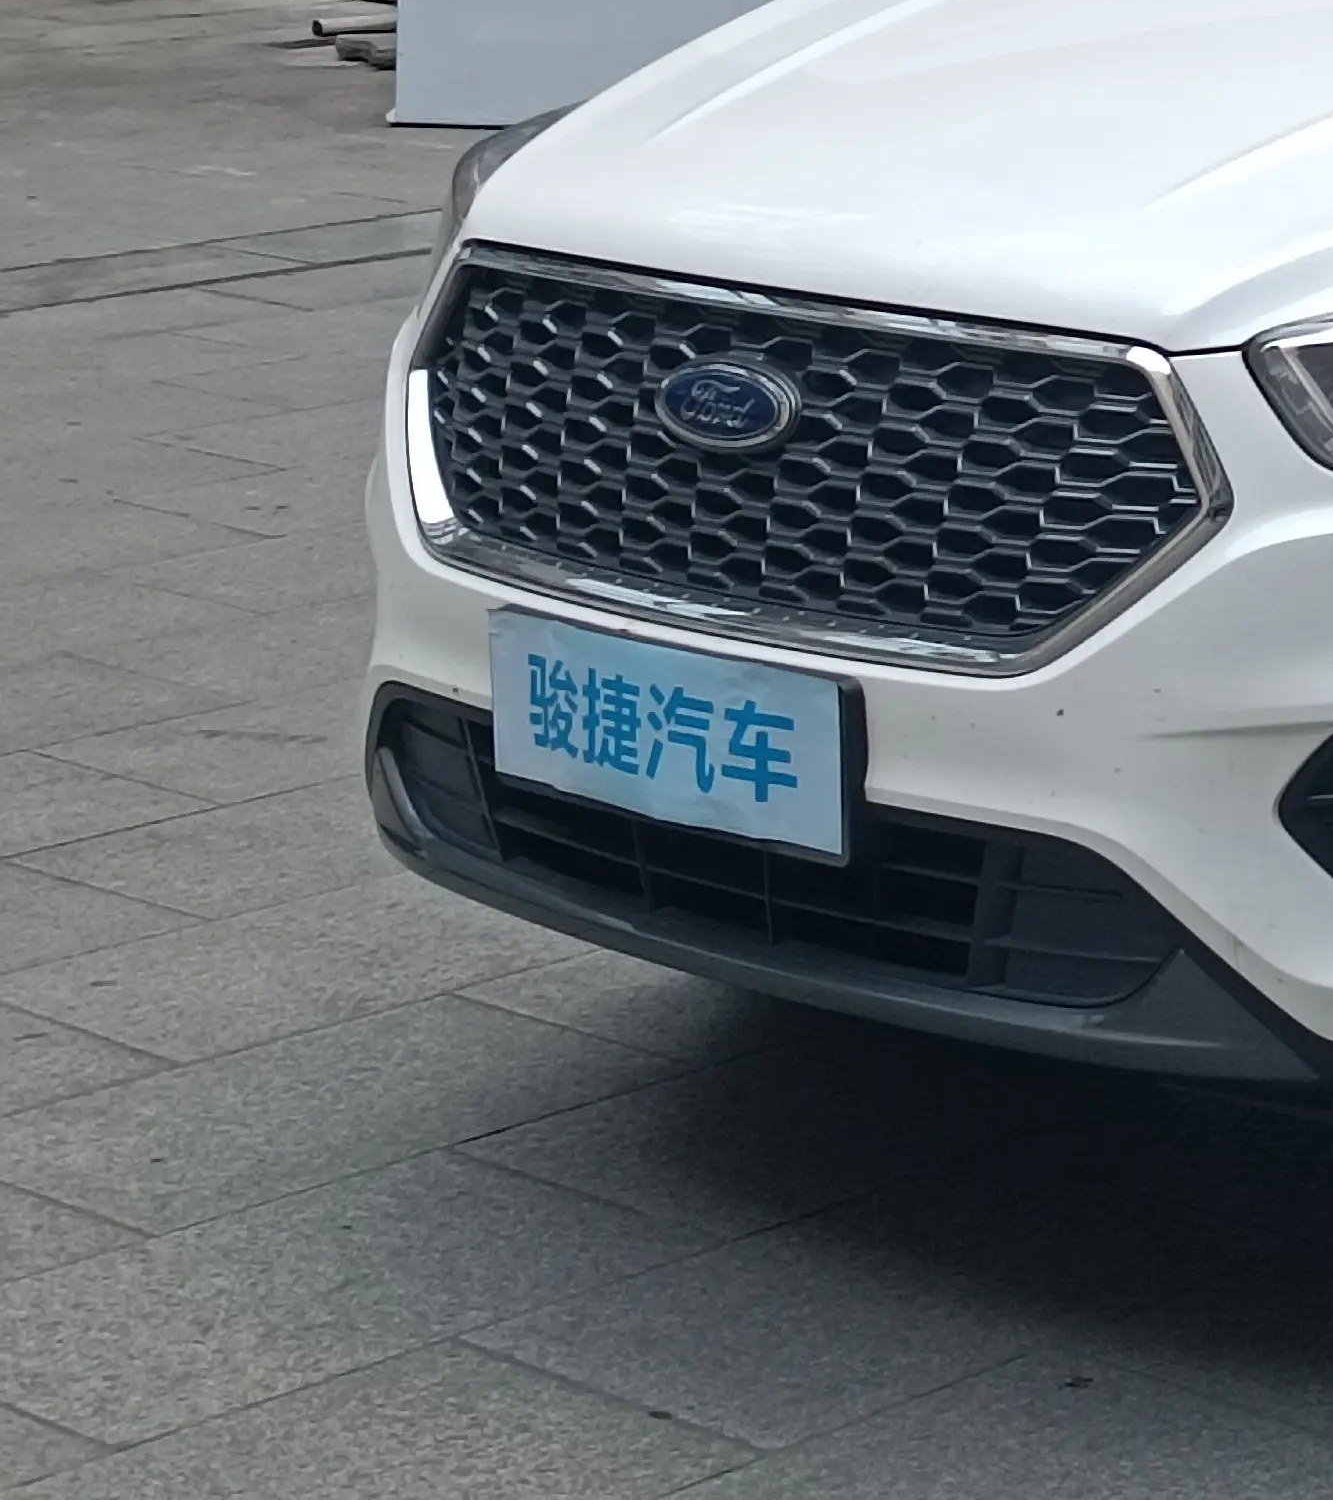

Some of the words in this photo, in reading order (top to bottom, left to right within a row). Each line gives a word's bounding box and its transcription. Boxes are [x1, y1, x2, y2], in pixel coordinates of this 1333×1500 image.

[679, 379, 756, 429] Ford
[528, 654, 799, 804] 骏捷汽车
